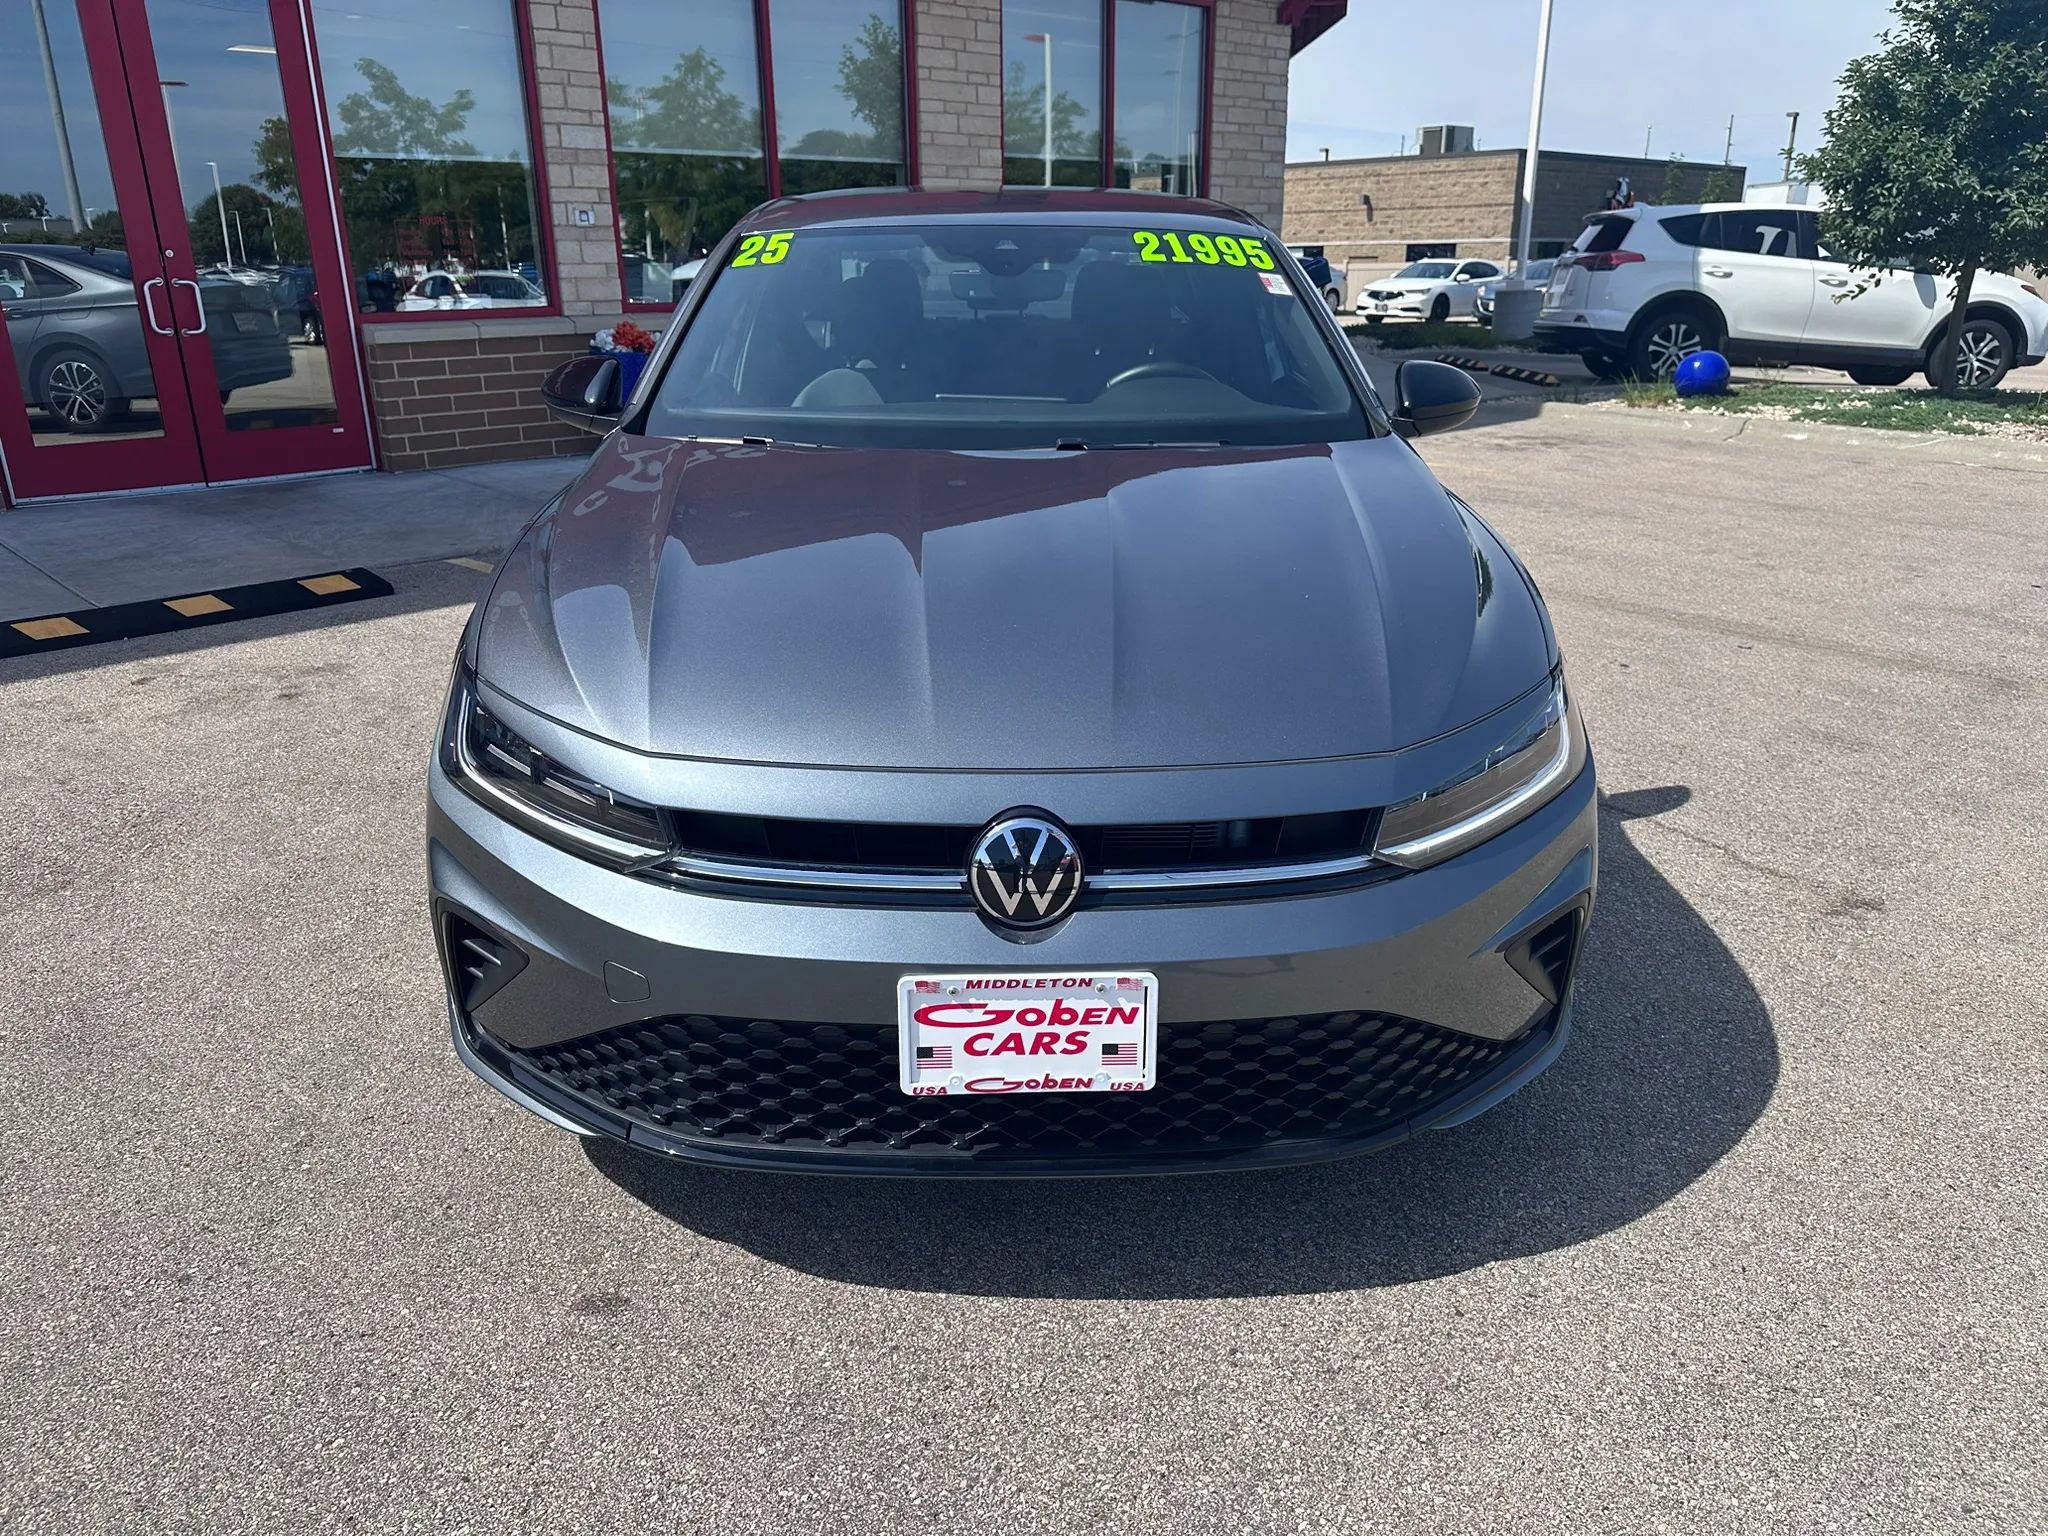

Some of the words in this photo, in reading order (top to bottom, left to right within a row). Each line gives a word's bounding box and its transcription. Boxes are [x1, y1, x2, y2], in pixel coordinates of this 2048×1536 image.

[731, 232, 795, 268] 25
[1132, 231, 1275, 270] 21995
[965, 978, 1093, 990] MIDDLETON
[963, 1030, 1091, 1057] CARS
[912, 1086, 948, 1096] USA
[1109, 1081, 1146, 1092] USA
